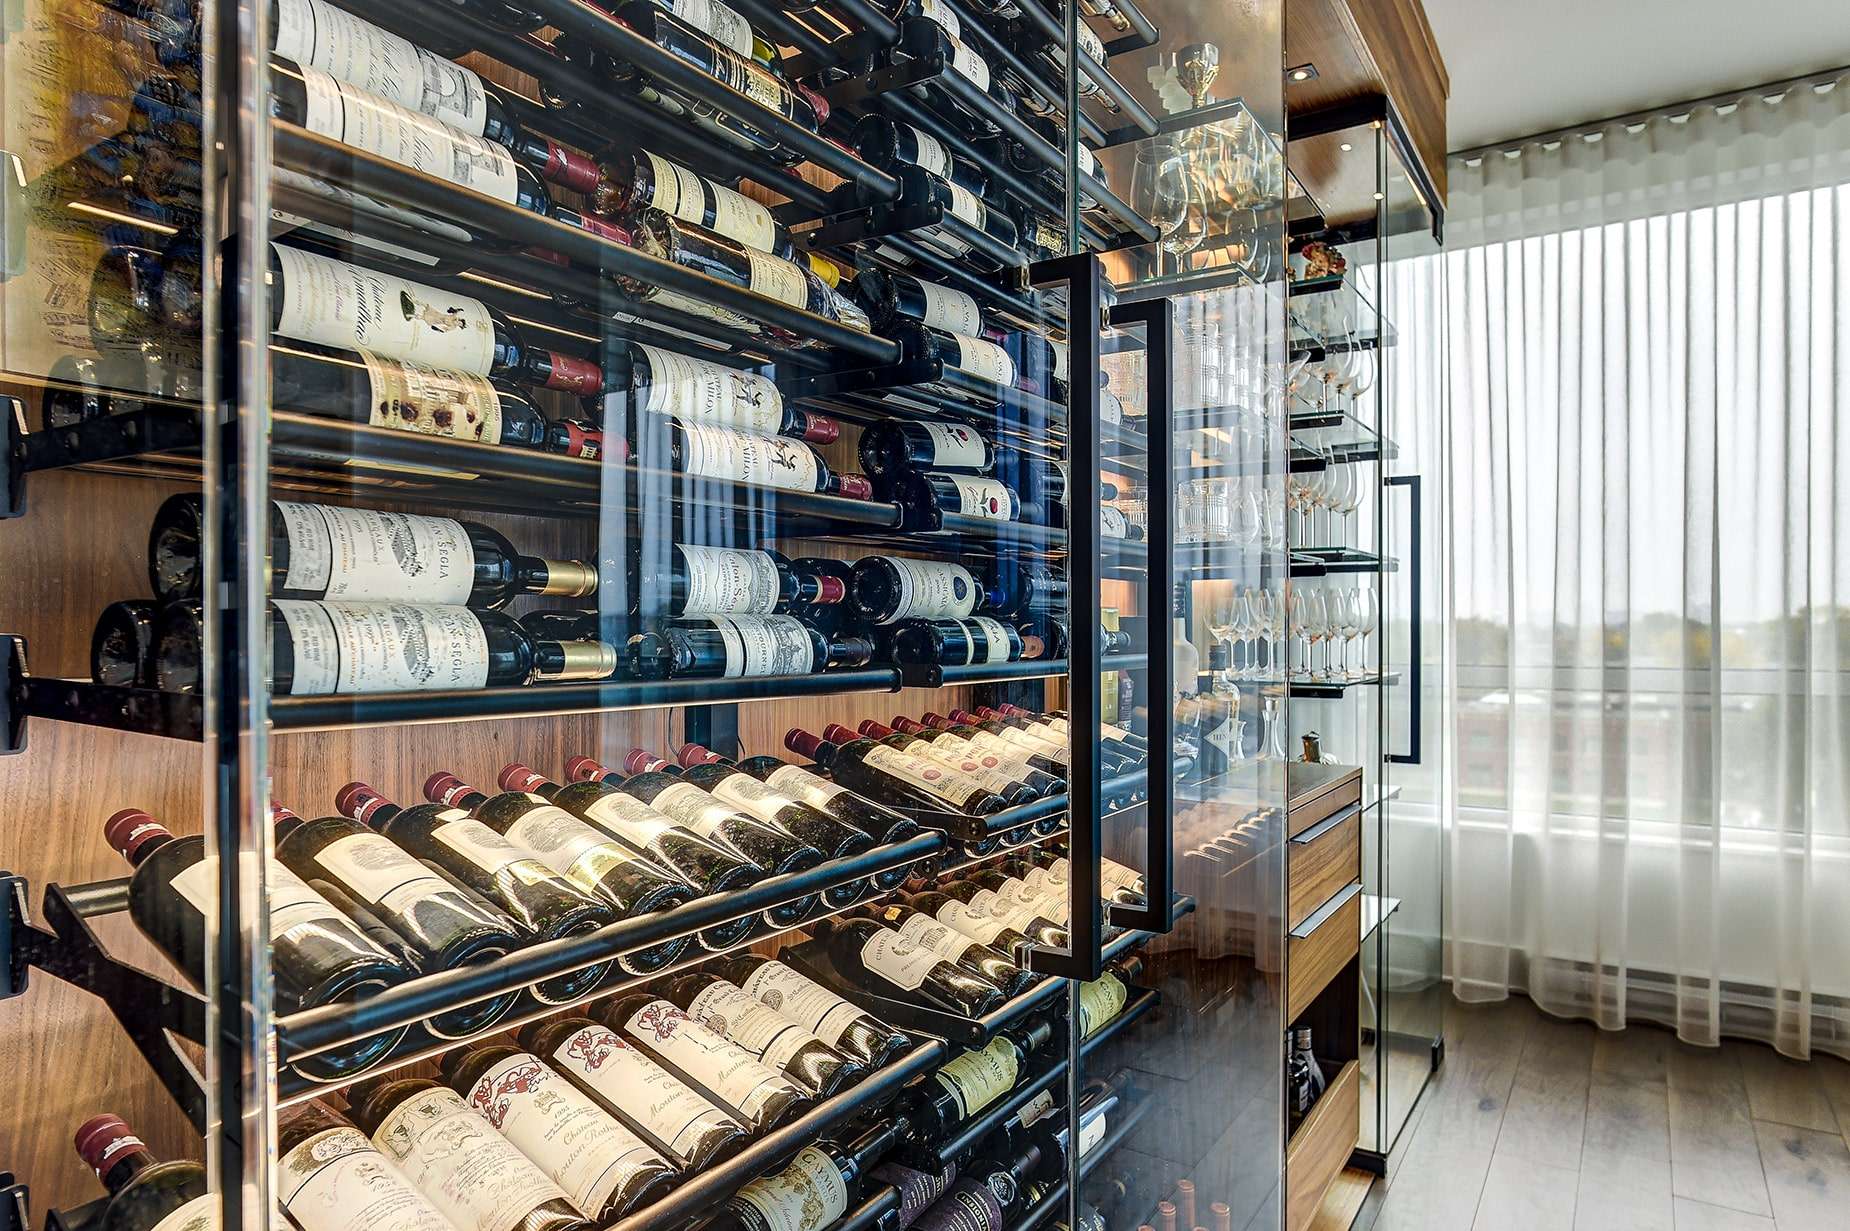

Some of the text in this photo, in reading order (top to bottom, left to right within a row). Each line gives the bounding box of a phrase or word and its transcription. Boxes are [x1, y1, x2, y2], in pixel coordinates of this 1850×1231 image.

[704, 381, 715, 414] MILON
[741, 447, 751, 481] MILON
[801, 1152, 839, 1205] CAYMUS
